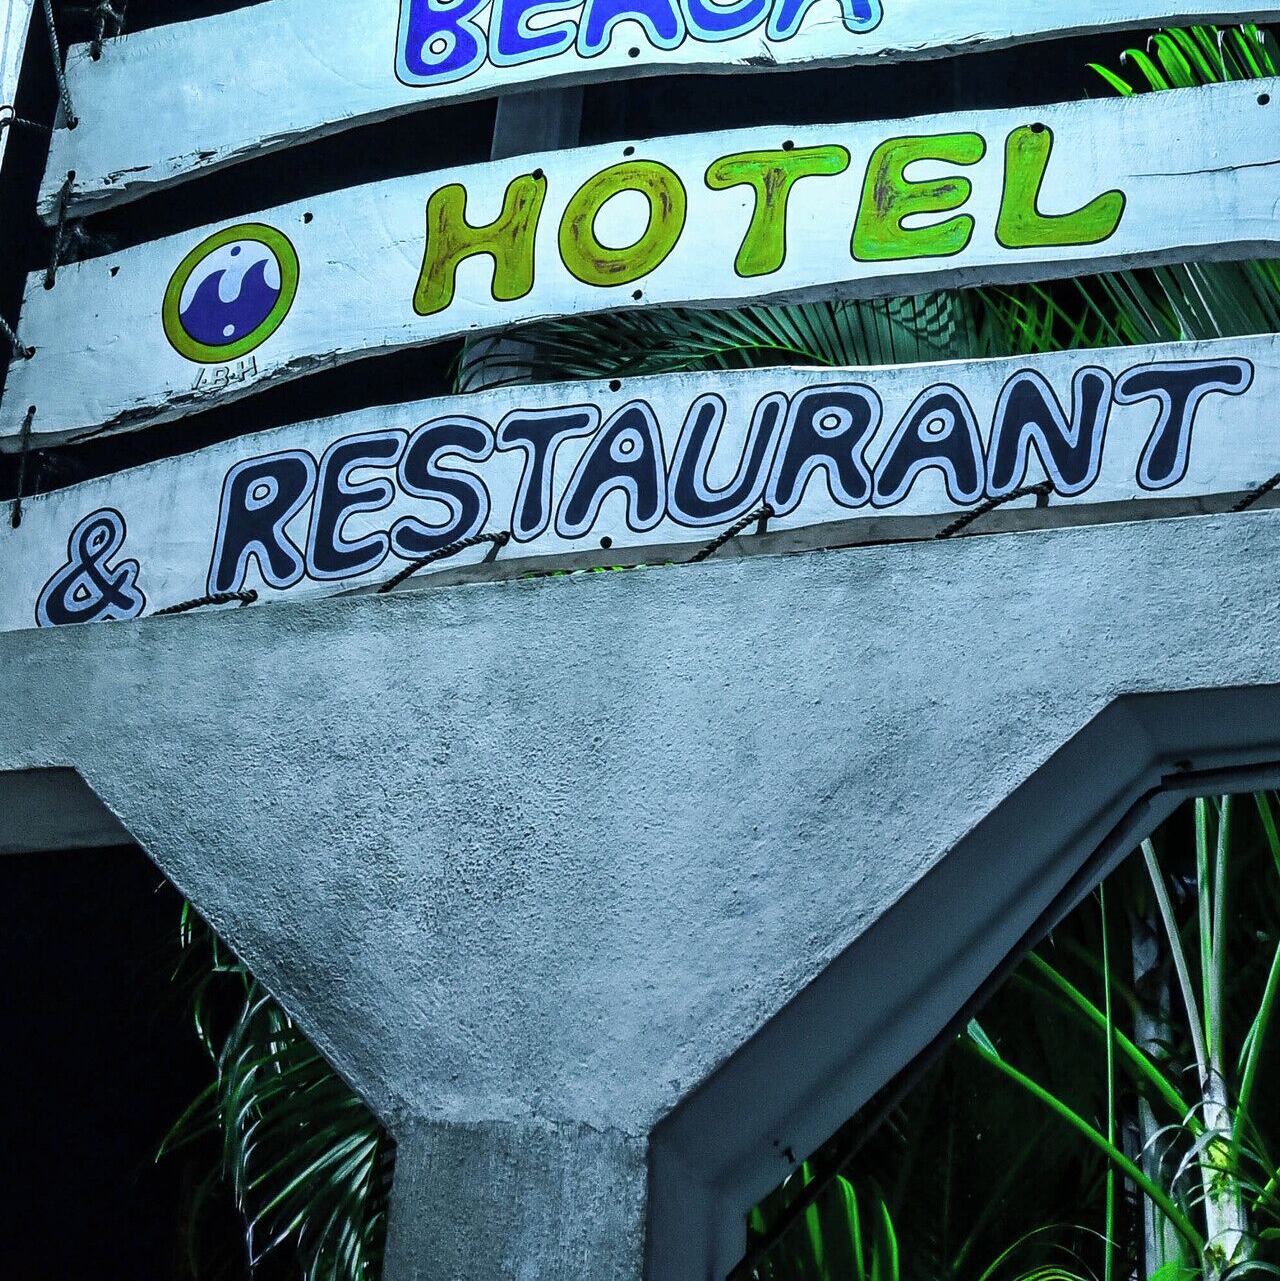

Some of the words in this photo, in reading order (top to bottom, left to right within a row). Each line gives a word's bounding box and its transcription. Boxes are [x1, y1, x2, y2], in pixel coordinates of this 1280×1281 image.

[412, 122, 1127, 318] HOTEL
[36, 507, 147, 627] &
[208, 357, 1255, 598] RESTAURANT
